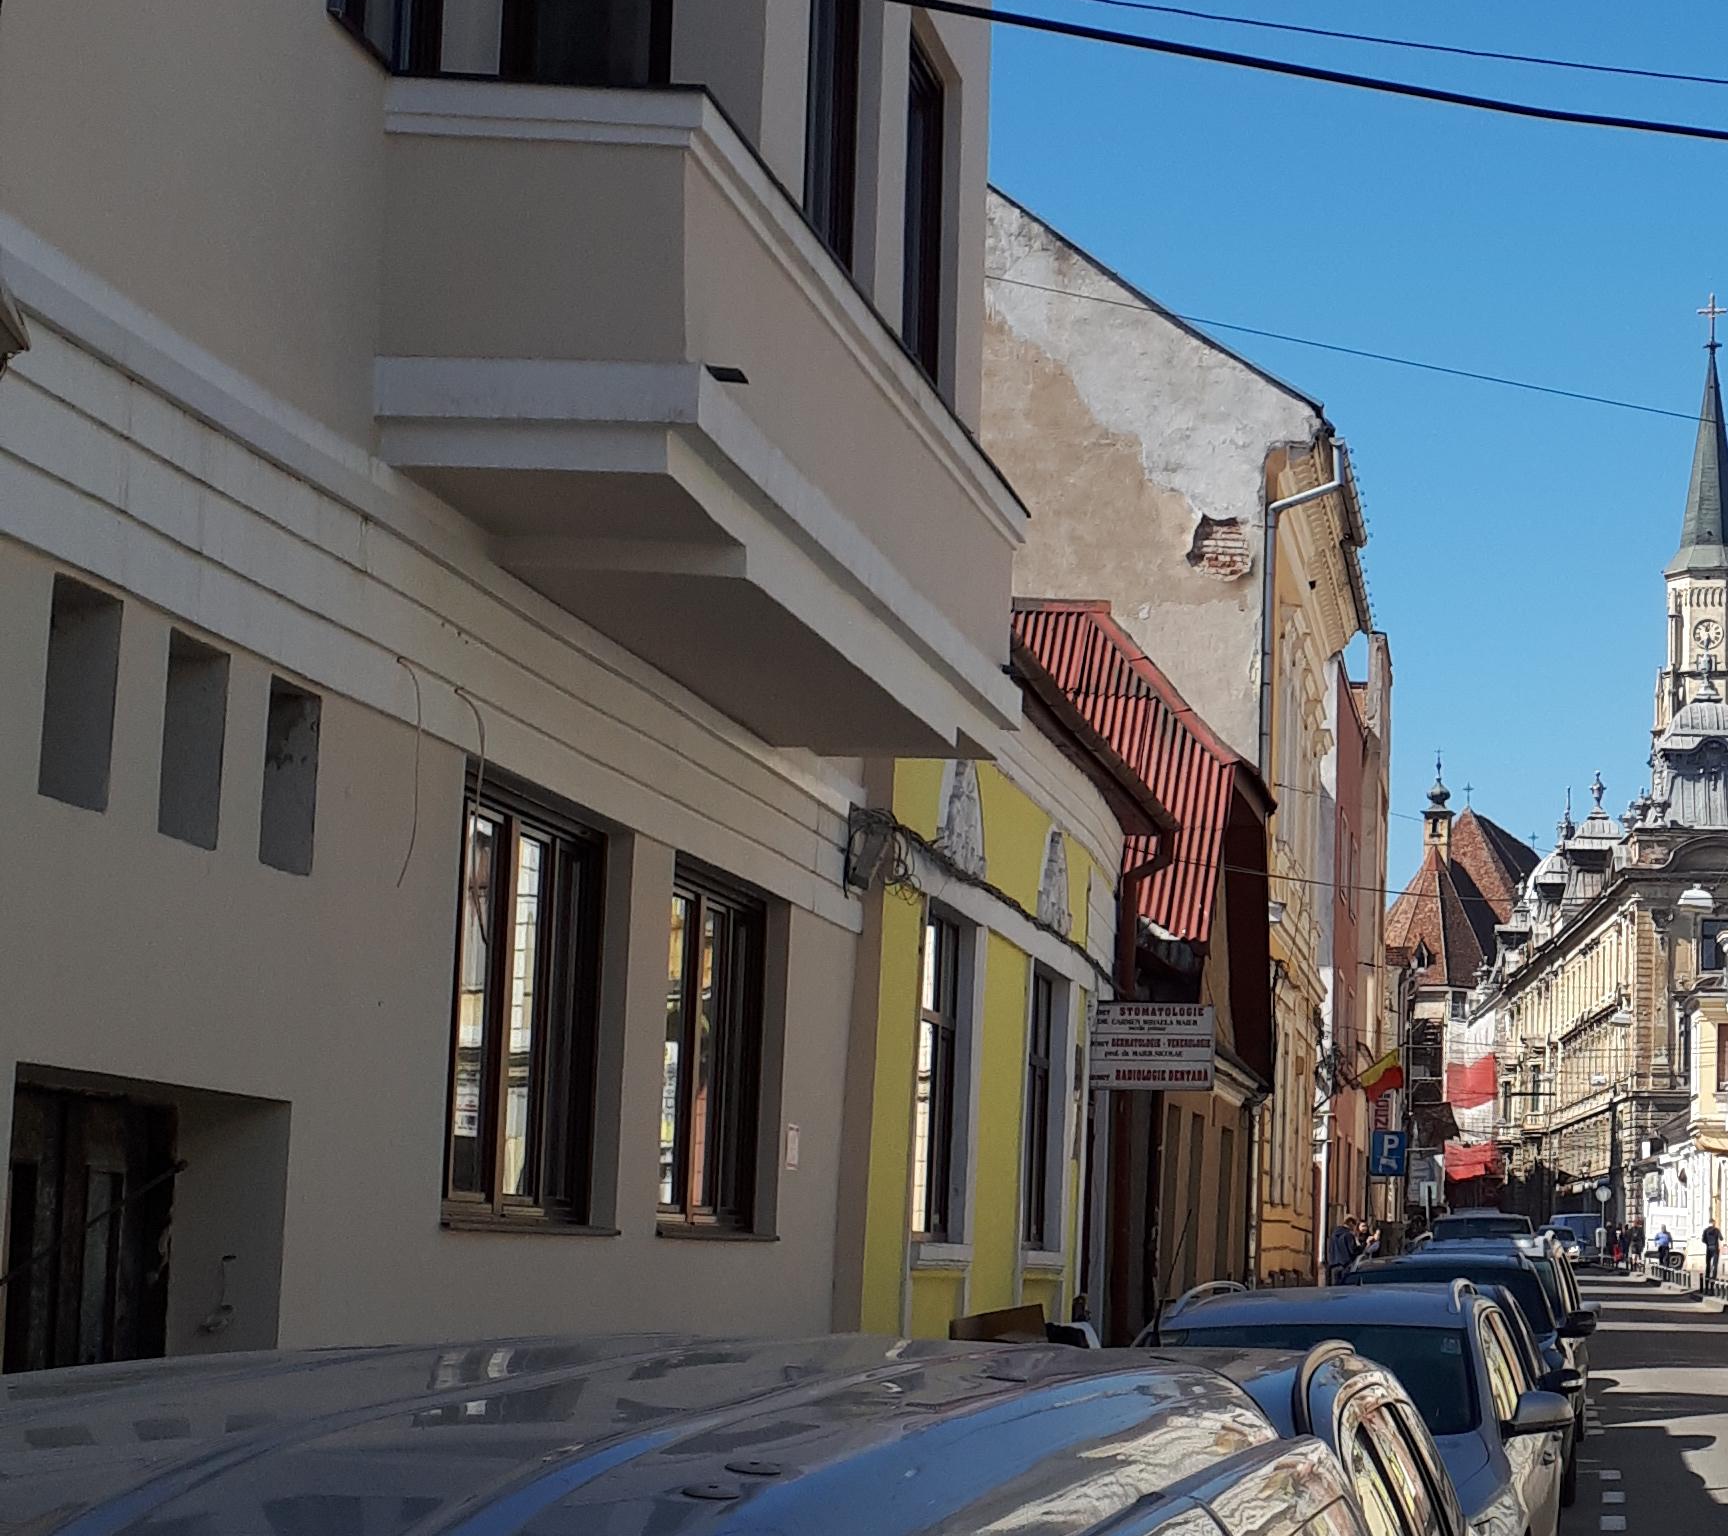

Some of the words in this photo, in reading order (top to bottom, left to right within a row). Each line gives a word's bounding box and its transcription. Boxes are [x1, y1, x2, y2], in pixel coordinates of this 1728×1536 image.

[1119, 1007, 1205, 1017] STOMATOLOGIE
[1115, 1069, 1167, 1081] RADIOLOGIE
[1384, 1135, 1399, 1156] P
